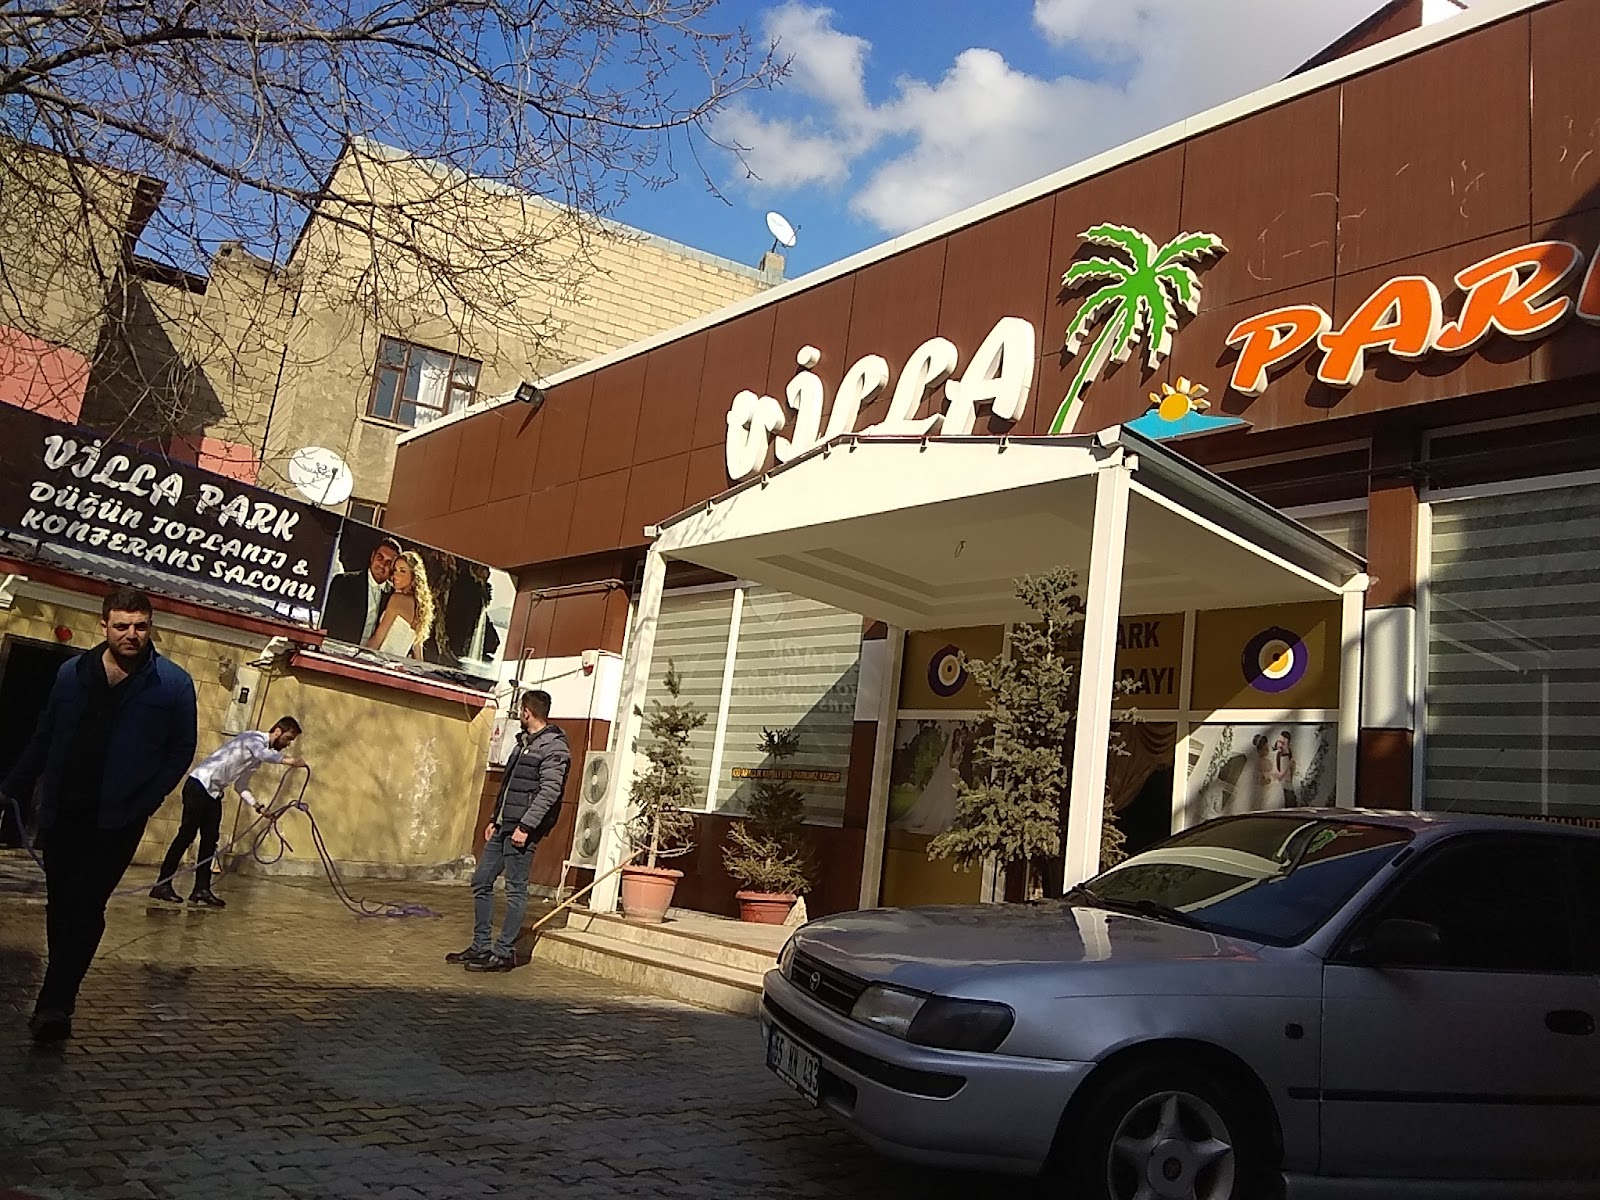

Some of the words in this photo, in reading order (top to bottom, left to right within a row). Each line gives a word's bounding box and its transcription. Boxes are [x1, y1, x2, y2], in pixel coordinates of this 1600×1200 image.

[44, 435, 183, 507] VİLLA
[190, 483, 301, 541] PARK
[21, 508, 205, 572] KONFERANS
[210, 560, 317, 602] SALONU
[292, 559, 309, 576] &
[1117, 621, 1160, 649] ARK
